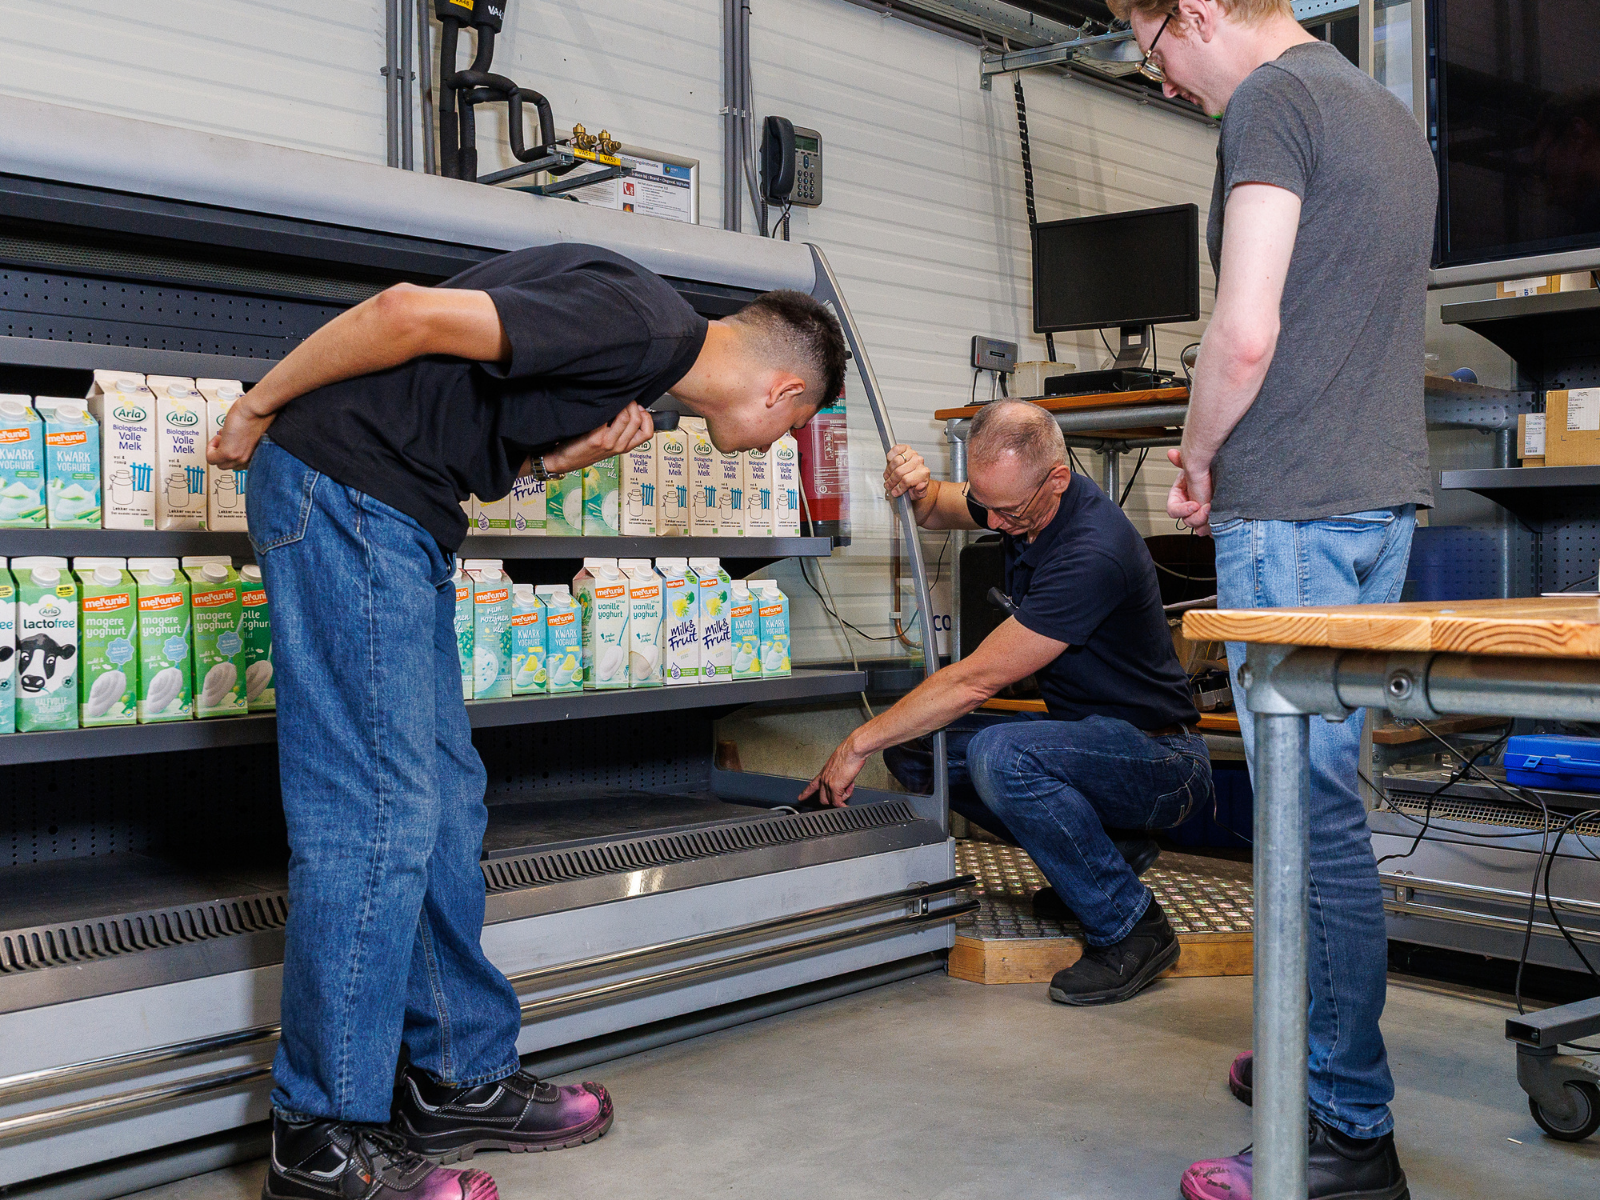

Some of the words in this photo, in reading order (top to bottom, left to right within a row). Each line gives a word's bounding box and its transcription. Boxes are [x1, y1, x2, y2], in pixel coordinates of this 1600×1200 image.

[118, 409, 141, 418] Arla
[170, 414, 192, 422] Arla
[113, 424, 147, 432] Biologische
[119, 432, 142, 441] Volle
[172, 436, 194, 444] Volle
[119, 442, 142, 450] Melk
[173, 446, 194, 454] Melk
[0, 448, 34, 460] KWARK
[56, 451, 90, 462] KWARK
[0, 460, 34, 470] YOGHURT
[56, 462, 90, 472] YOGHURT
[512, 482, 546, 501] Fruit
[85, 595, 128, 608] melkunie
[140, 594, 181, 608] melkunie
[195, 590, 234, 604] melkunie
[242, 591, 266, 602] elkuni
[197, 612, 232, 622] magere
[242, 610, 260, 618] olle
[598, 610, 623, 620] yoghurt
[633, 610, 658, 620] yoghurt
[24, 618, 75, 629] lactofree
[86, 618, 124, 629] magere
[142, 616, 178, 627] magere
[197, 620, 234, 632] yoghurt
[243, 620, 270, 630] oghur
[86, 626, 126, 638] yoghurt
[142, 624, 182, 637] yoghurt
[493, 622, 504, 632] vla
[671, 621, 692, 636] Milk
[705, 620, 726, 634] Milk
[518, 629, 540, 638] KWARK
[555, 628, 578, 638] KWARK
[702, 626, 731, 650] Fruit
[668, 628, 698, 651] Fruit
